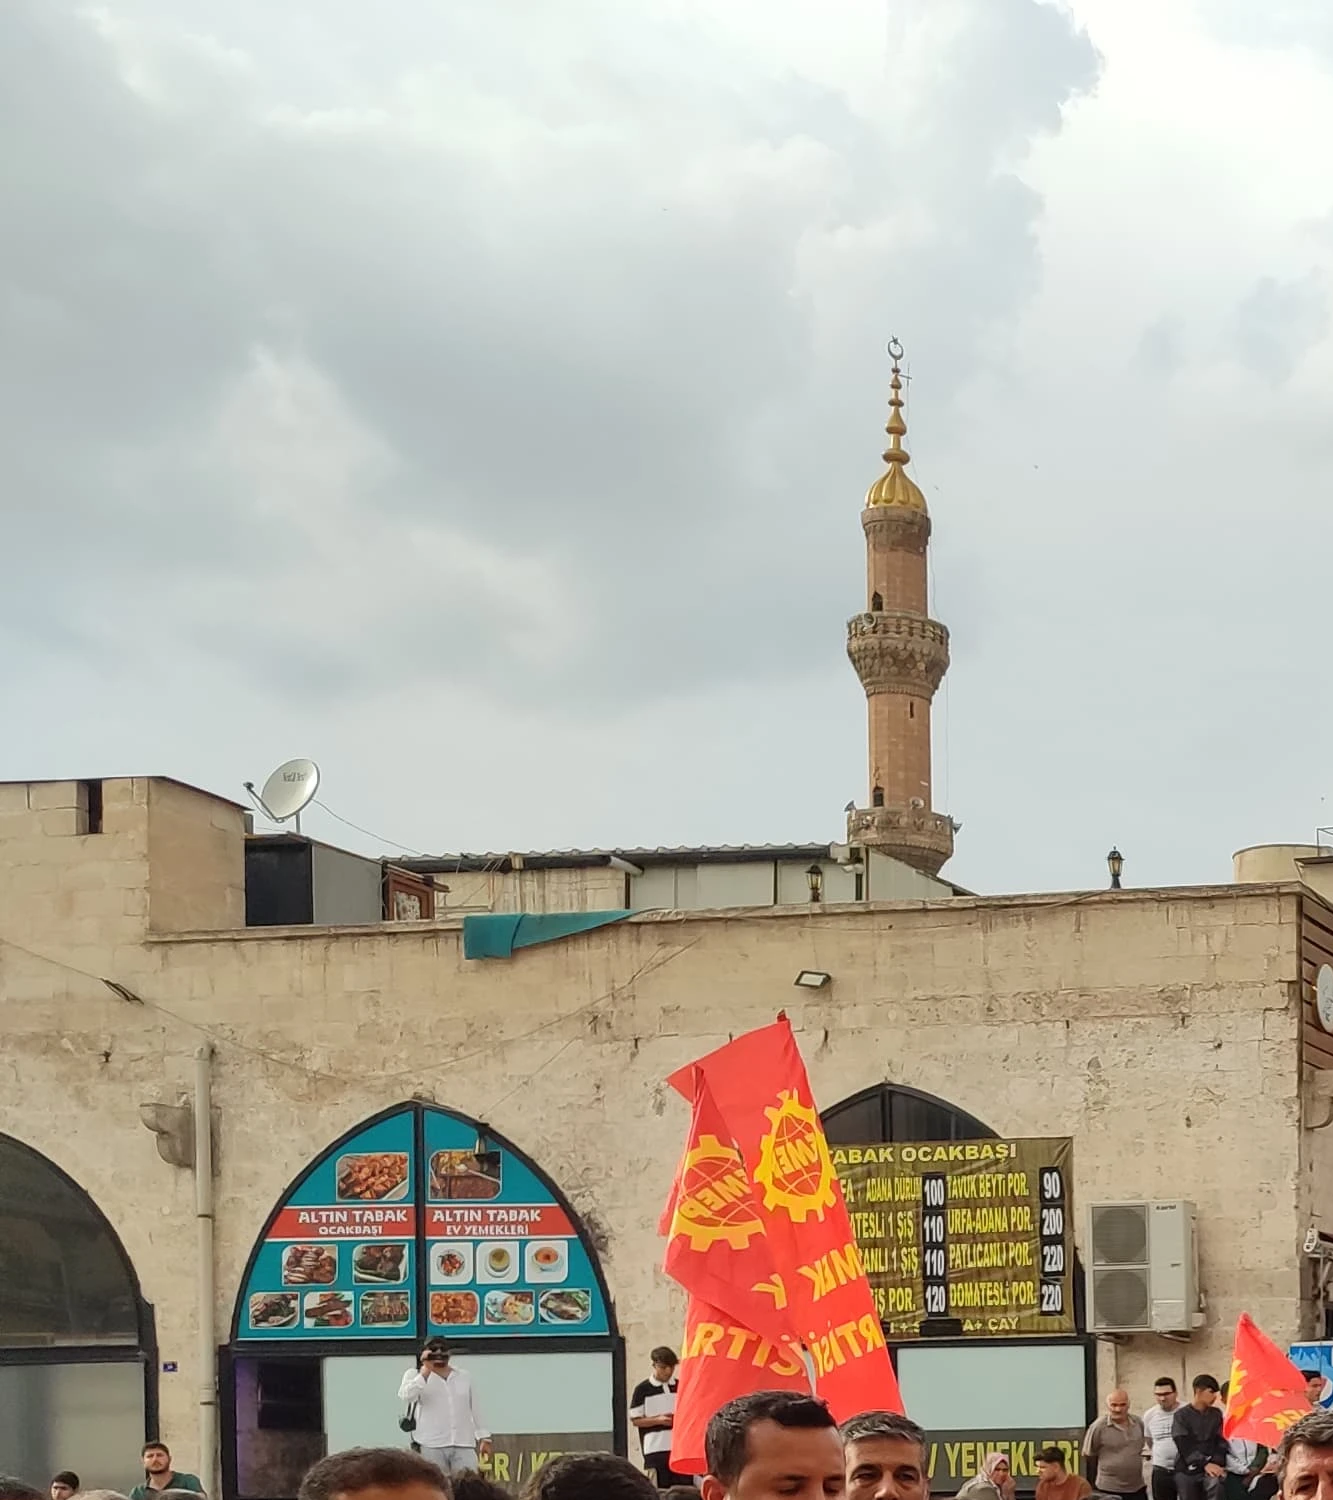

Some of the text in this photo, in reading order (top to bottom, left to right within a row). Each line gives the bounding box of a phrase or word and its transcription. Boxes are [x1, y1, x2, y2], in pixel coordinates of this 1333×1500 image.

[901, 1143, 1017, 1163] OCAKBAŞI
[924, 1179, 945, 1207] 100
[947, 1174, 978, 1199] TAVUK
[1008, 1172, 1030, 1197] POR.
[1043, 1171, 1061, 1199] 90
[298, 1209, 408, 1224] ALTIN TABAK
[432, 1209, 542, 1223] ALTIN TABAK
[924, 1215, 945, 1244] 110
[1010, 1206, 1034, 1232] POR.
[1042, 1208, 1064, 1236] 200
[318, 1225, 383, 1237] OCAKBAŞI
[446, 1225, 462, 1236] EV
[925, 1249, 945, 1277] 110
[1008, 1242, 1033, 1266] POR.
[1043, 1244, 1064, 1272] 220
[888, 1287, 917, 1312] POR.
[925, 1285, 946, 1313] 120
[1041, 1284, 1063, 1312] 220
[988, 1316, 1019, 1334] ÇAY
